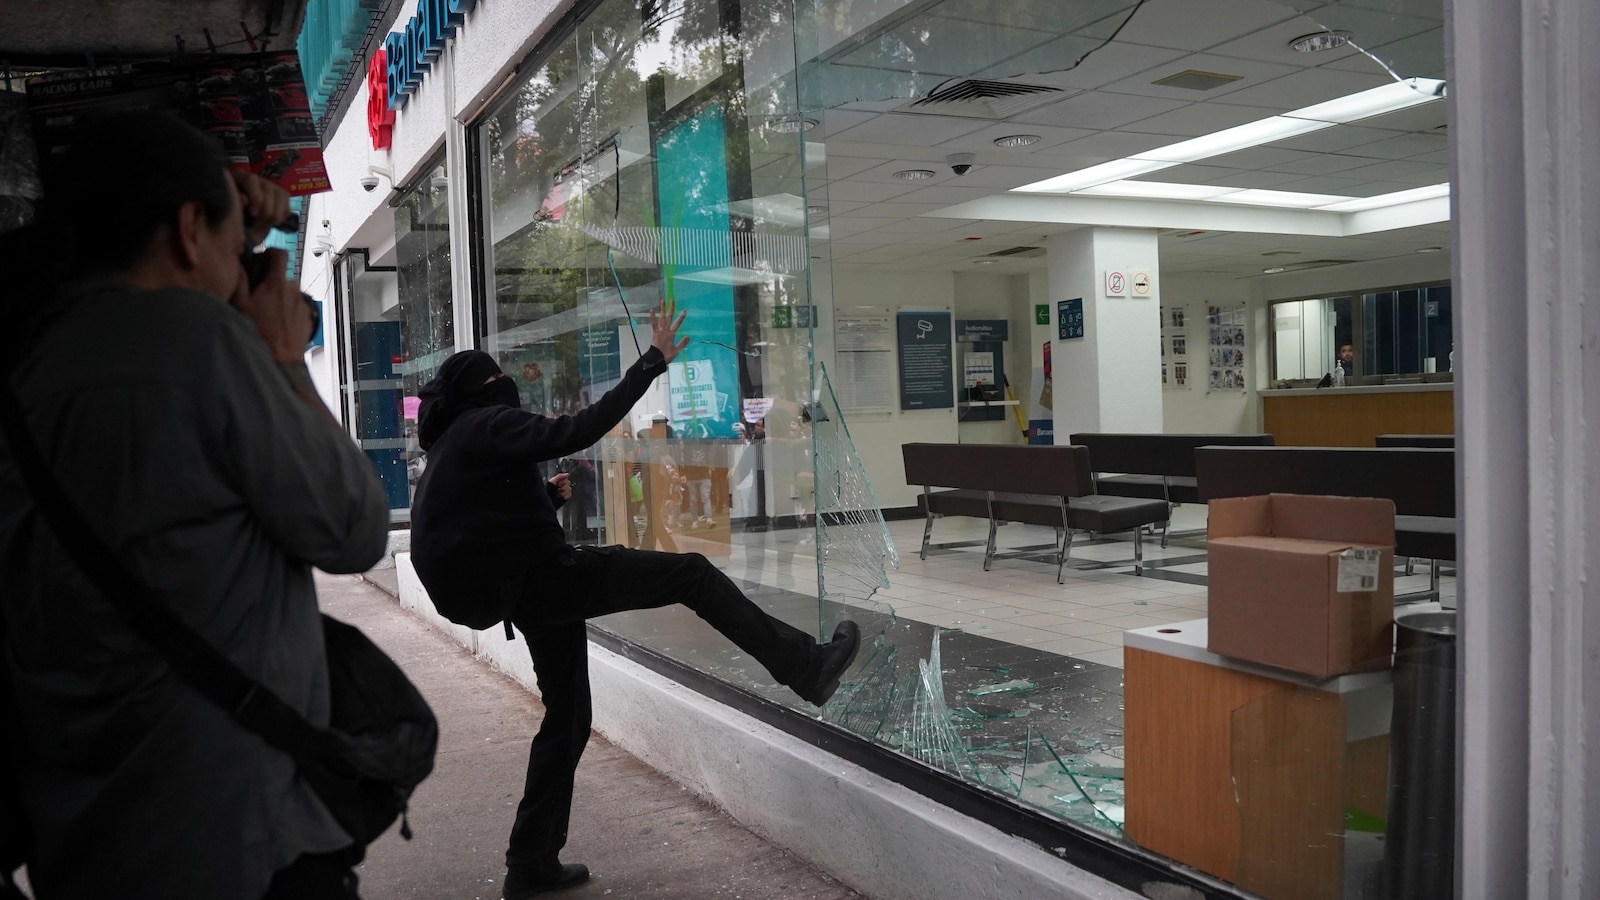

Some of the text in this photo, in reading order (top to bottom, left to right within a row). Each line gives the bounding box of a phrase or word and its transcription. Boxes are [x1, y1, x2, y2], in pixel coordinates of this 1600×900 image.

[385, 0, 473, 110] Banam
[32, 77, 113, 97] RACING CARS
[1427, 304, 1435, 315] 2
